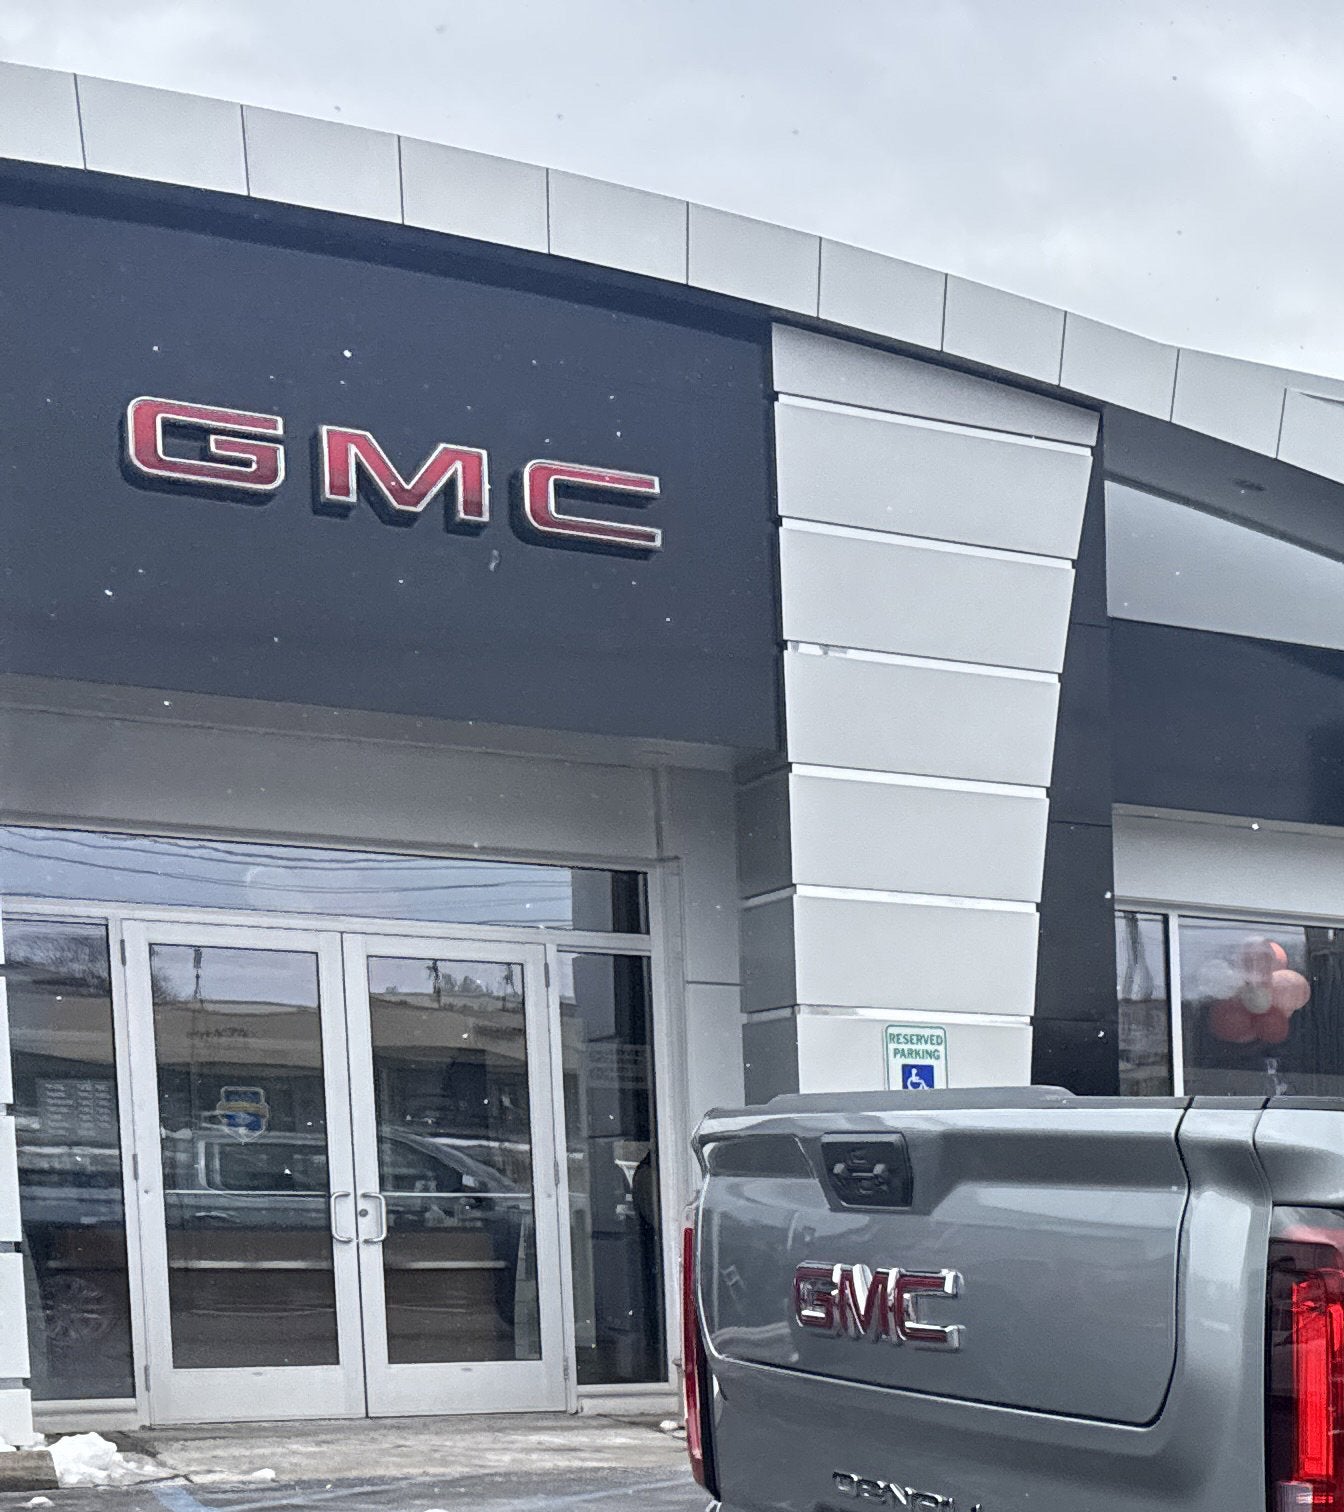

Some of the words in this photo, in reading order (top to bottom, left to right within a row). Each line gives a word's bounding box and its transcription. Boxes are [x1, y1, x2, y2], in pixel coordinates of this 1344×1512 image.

[127, 396, 662, 550] GMC
[888, 1033, 943, 1046] RESERVED
[893, 1048, 941, 1060] PARKING
[793, 1260, 966, 1352] GMC
